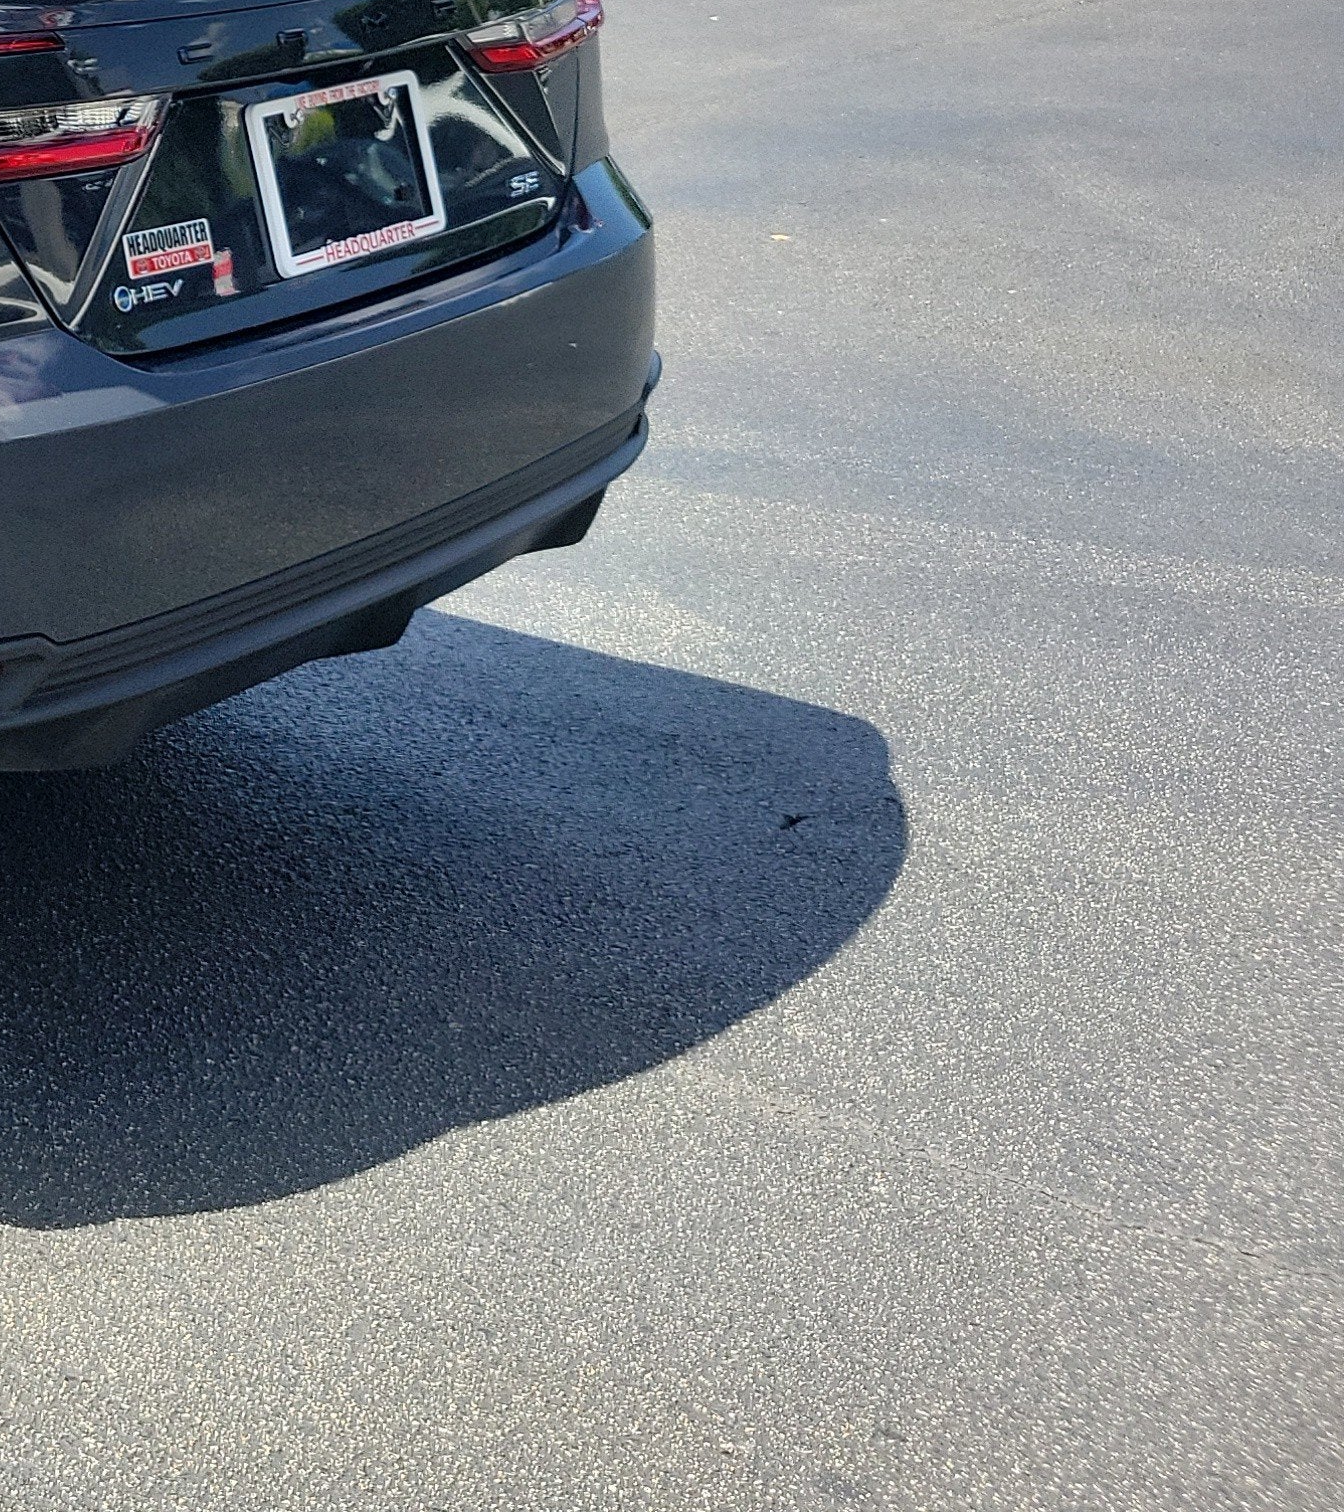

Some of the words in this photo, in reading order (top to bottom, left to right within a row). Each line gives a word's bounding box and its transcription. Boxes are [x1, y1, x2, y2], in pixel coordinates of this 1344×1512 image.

[510, 170, 539, 197] SE
[126, 221, 209, 257] HEADQUARTER
[325, 222, 416, 262] HEADQUARTER
[152, 250, 193, 269] TOYOTA
